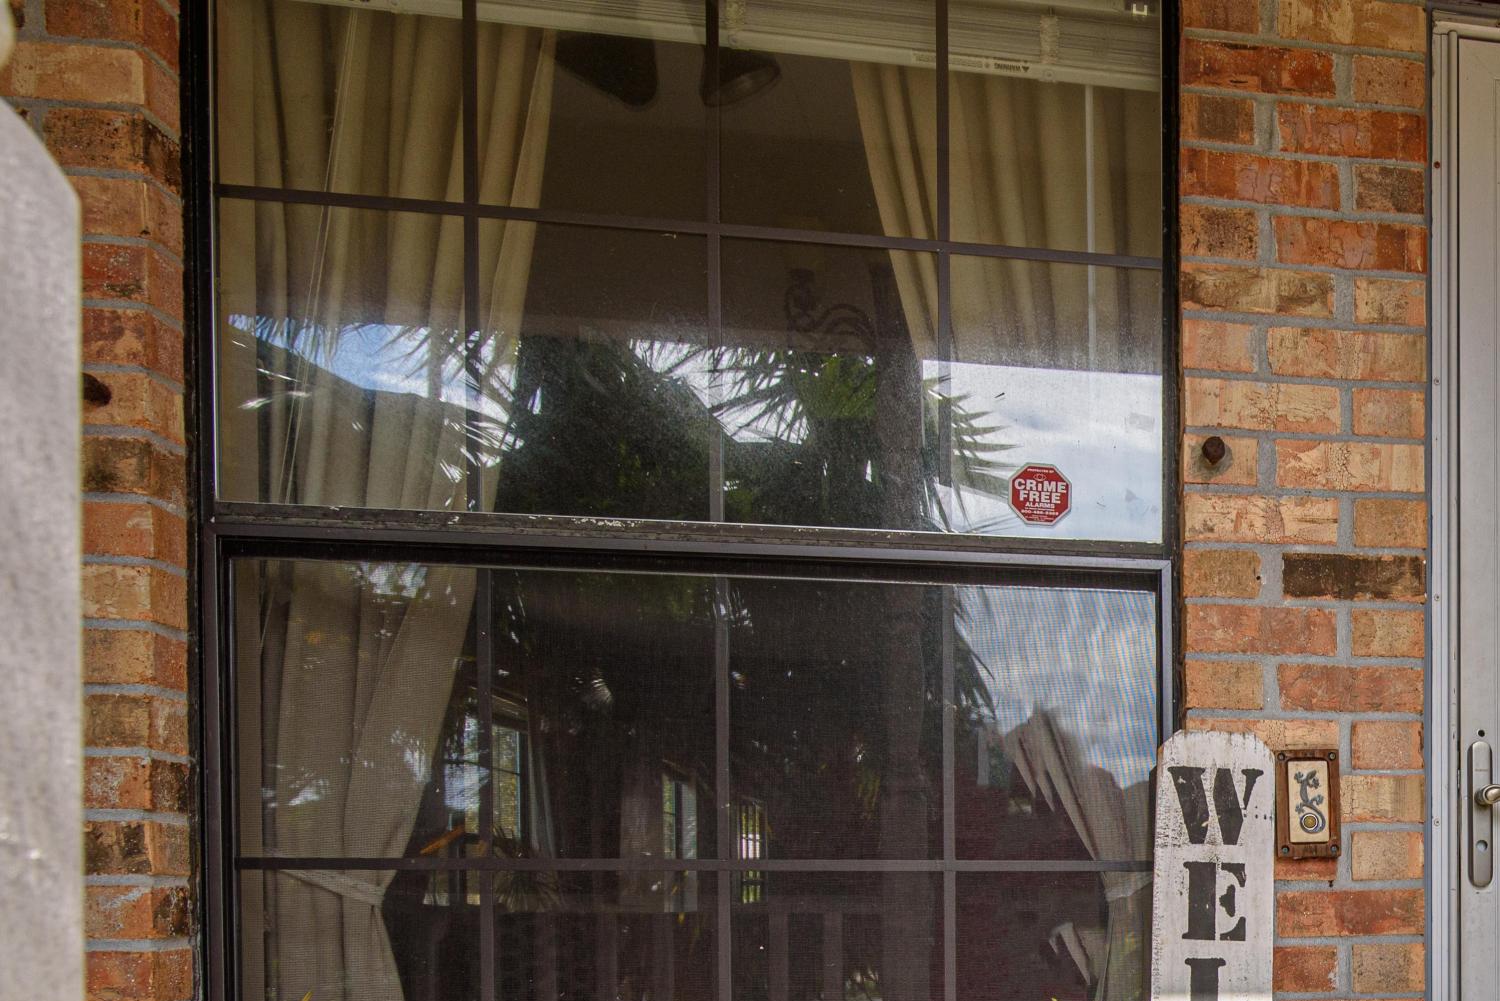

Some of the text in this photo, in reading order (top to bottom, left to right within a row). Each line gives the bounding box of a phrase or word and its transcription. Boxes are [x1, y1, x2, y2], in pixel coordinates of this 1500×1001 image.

[994, 63, 1021, 72] WARNING
[1019, 490, 1061, 504] FREE
[1025, 501, 1055, 509] ALARMS
